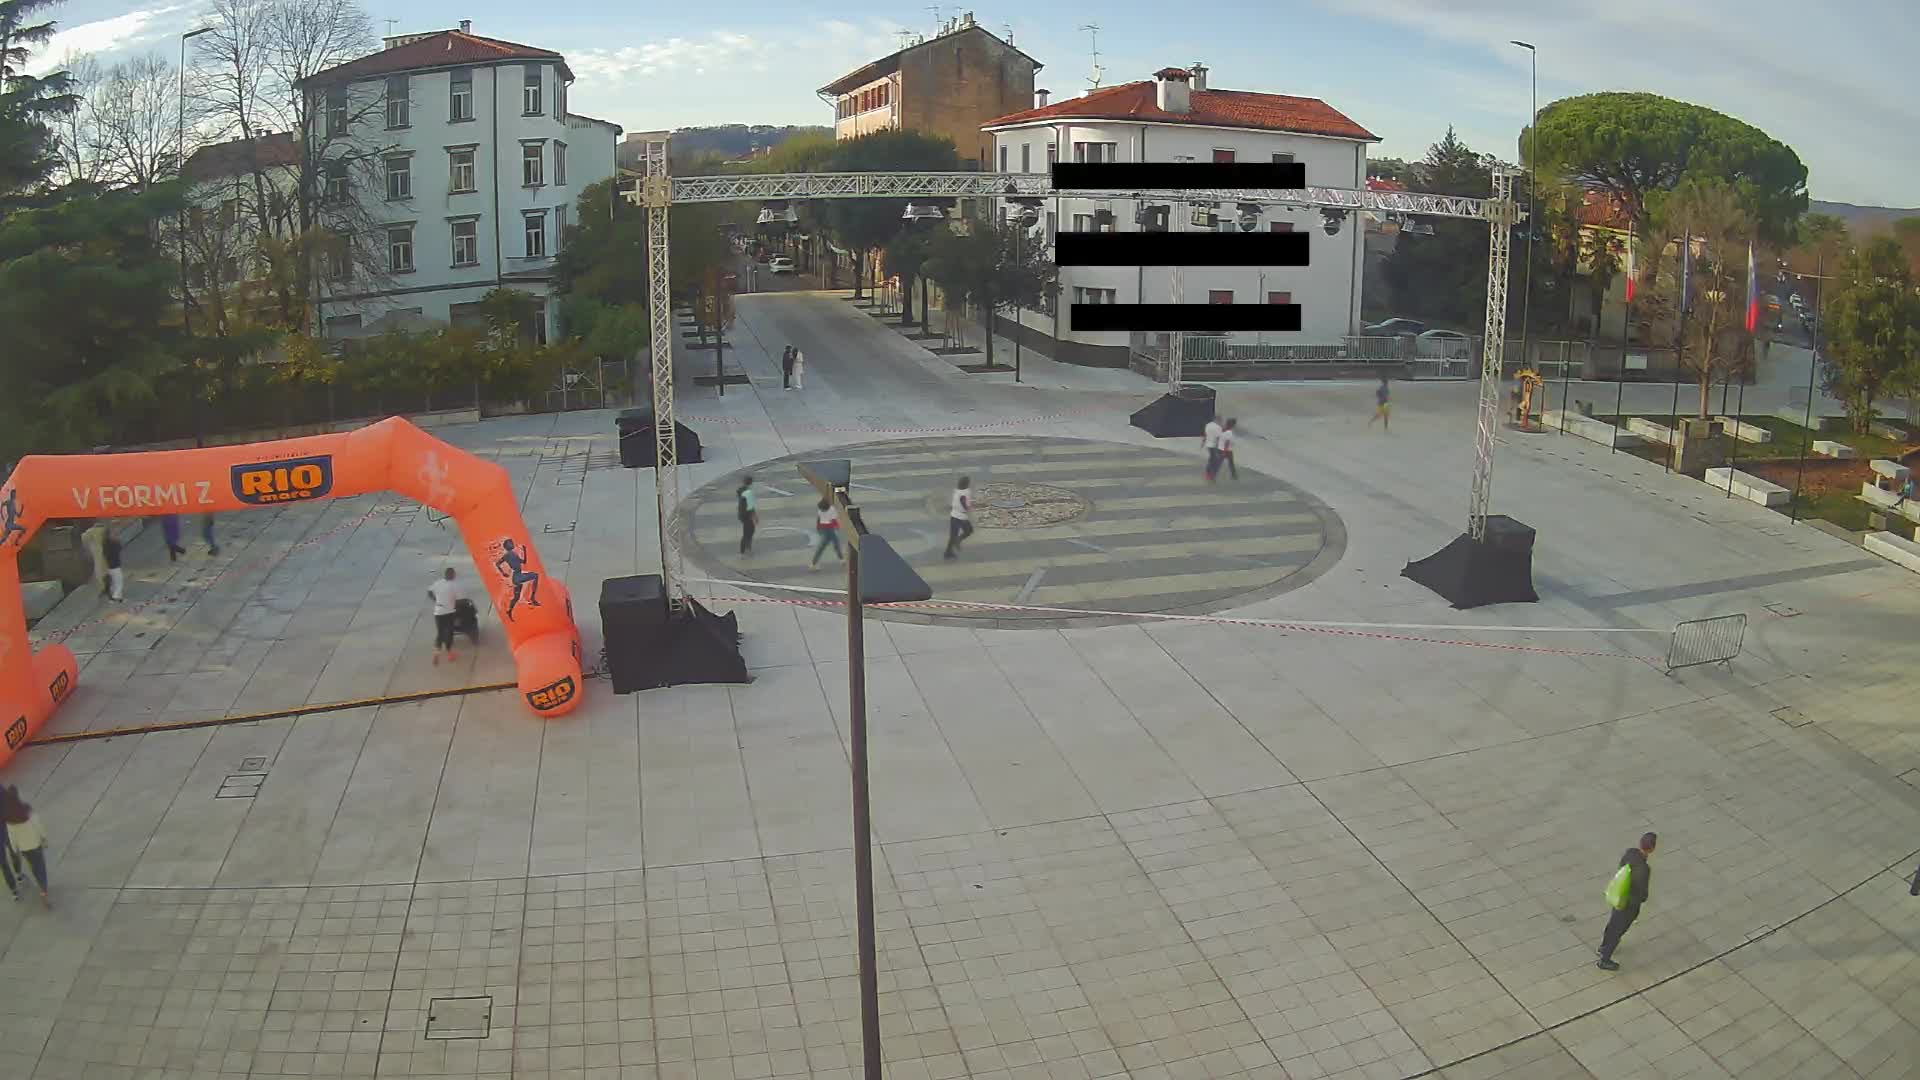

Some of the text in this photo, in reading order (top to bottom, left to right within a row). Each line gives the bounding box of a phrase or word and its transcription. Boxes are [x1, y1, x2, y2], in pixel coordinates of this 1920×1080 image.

[72, 480, 215, 511] V FORMI Z
[241, 464, 323, 496] RIO
[532, 682, 571, 705] RIO
